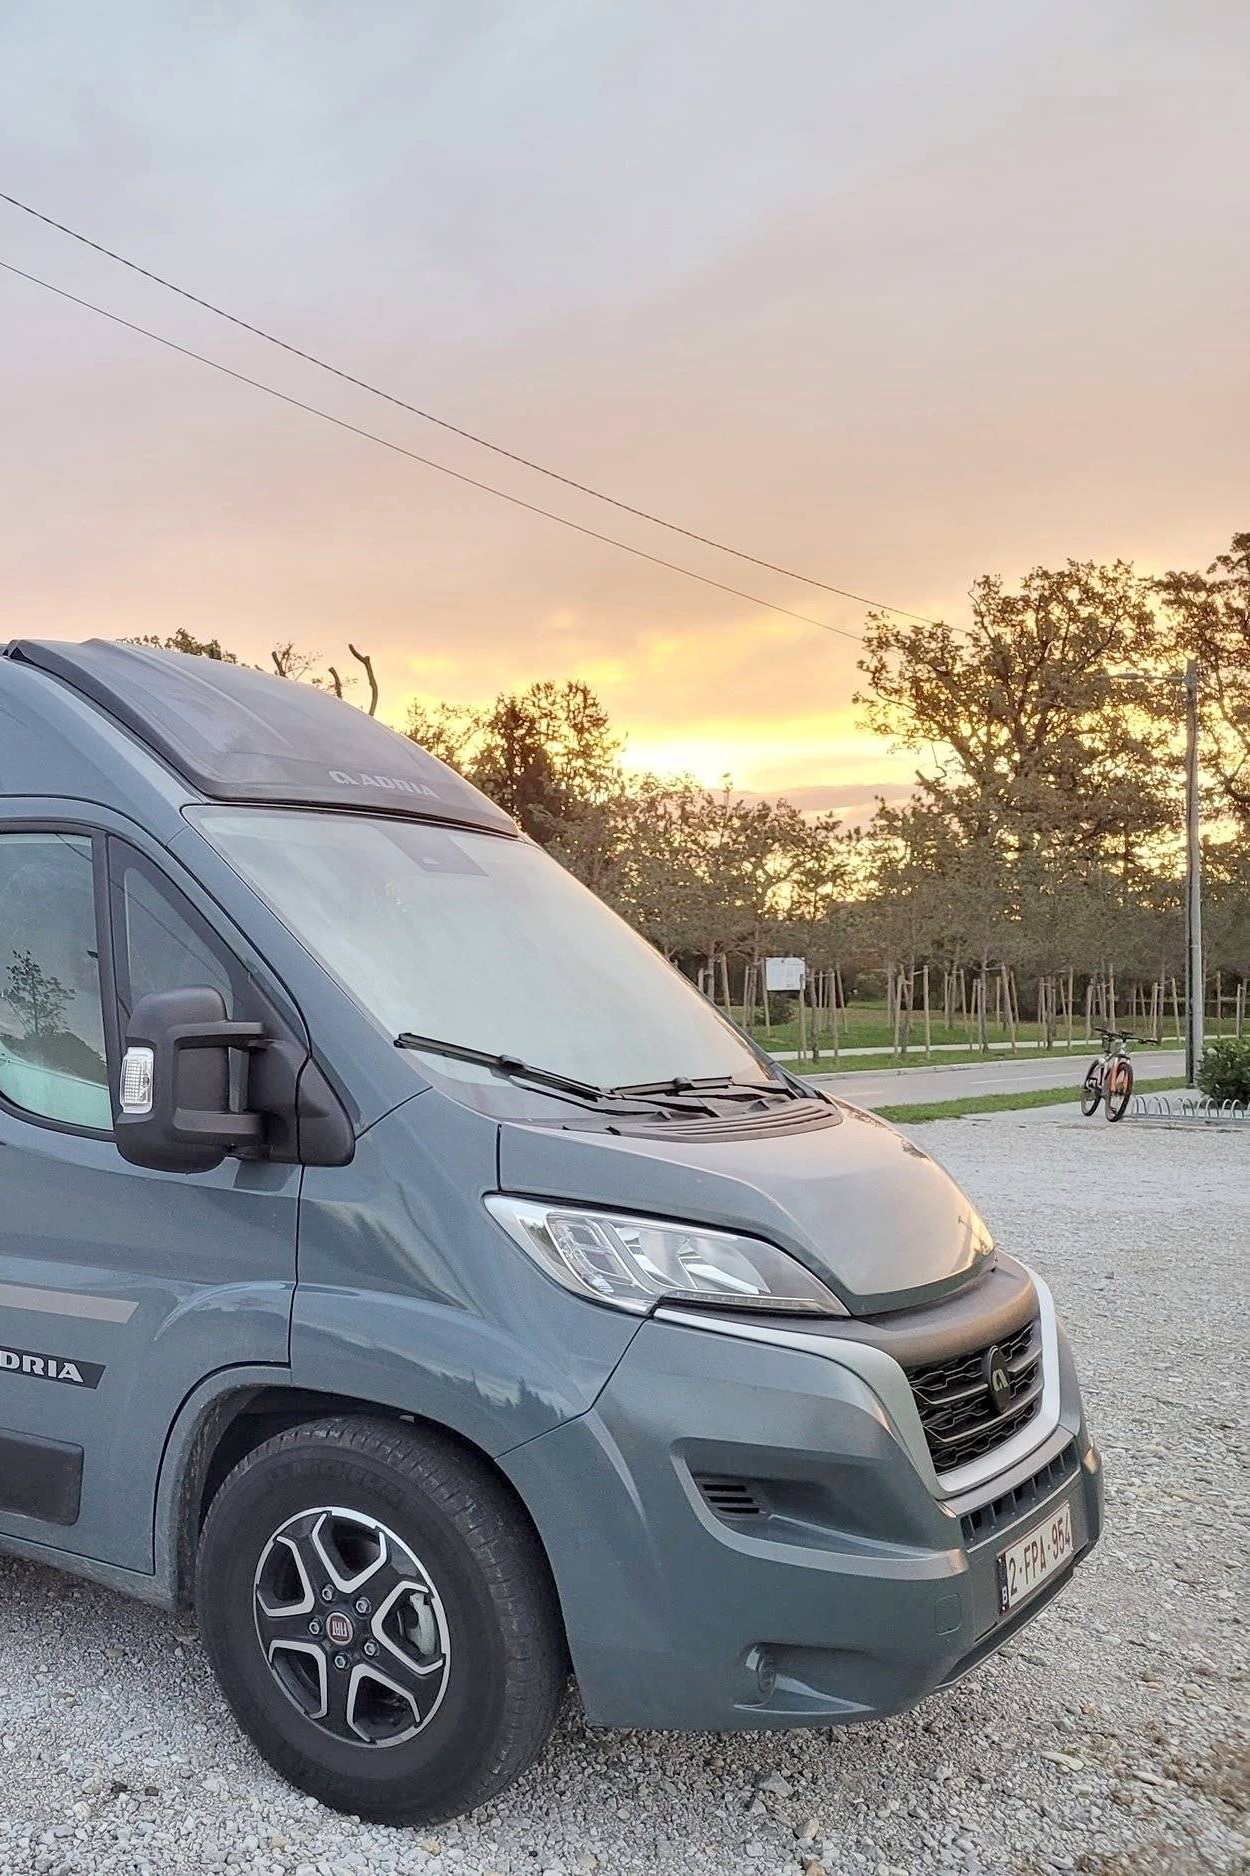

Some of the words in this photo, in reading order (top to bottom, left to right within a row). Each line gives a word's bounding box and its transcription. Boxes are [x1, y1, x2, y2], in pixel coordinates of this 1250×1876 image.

[358, 773, 440, 799] ADRIA
[1001, 1586, 1008, 1605] B
[331, 1620, 348, 1637] FIAT
